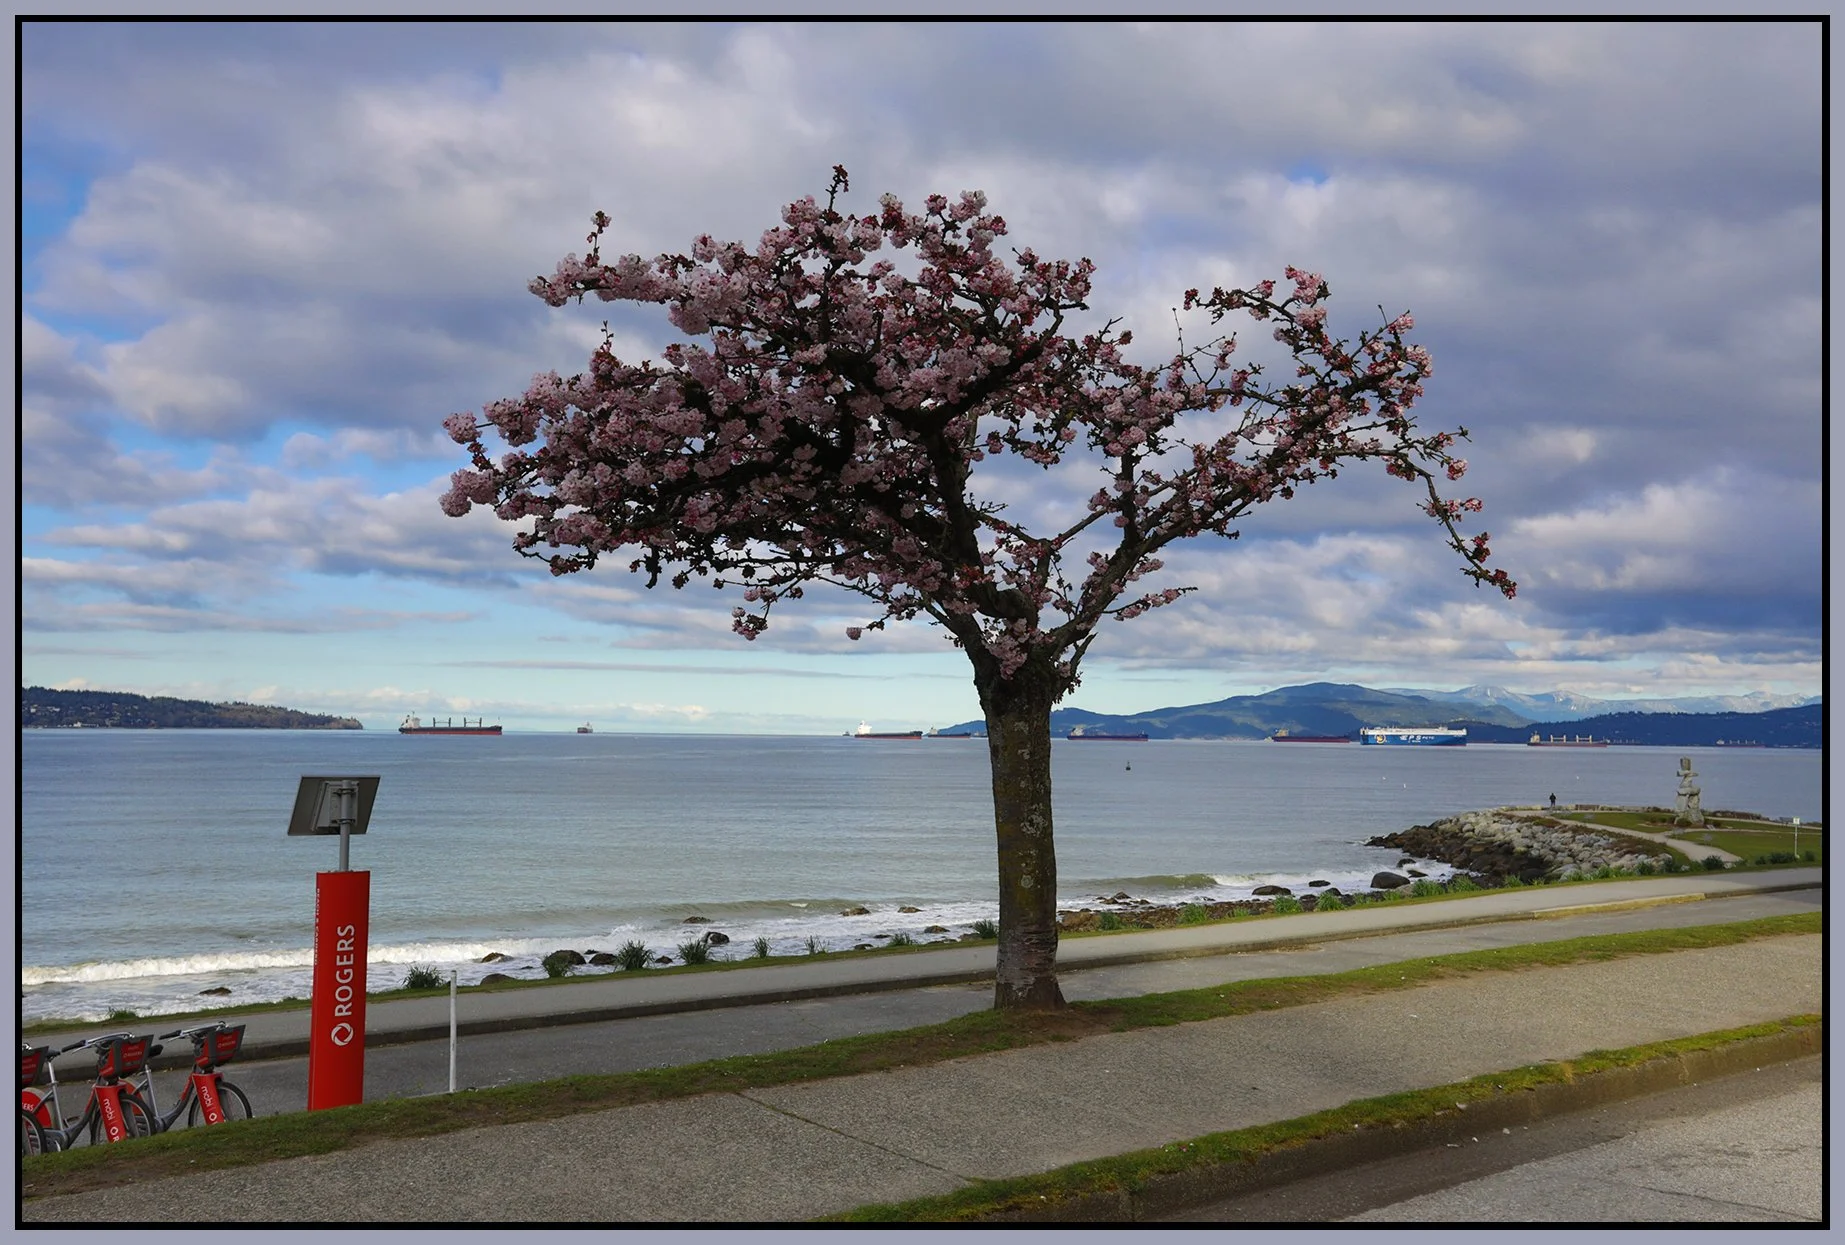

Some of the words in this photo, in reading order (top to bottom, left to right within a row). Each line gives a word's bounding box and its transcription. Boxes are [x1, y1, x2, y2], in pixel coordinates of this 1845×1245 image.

[335, 924, 355, 1017] ROGERS
[22, 1102, 34, 1113] ERS
[201, 1086, 213, 1107] mobi
[103, 1098, 115, 1121] mobi
